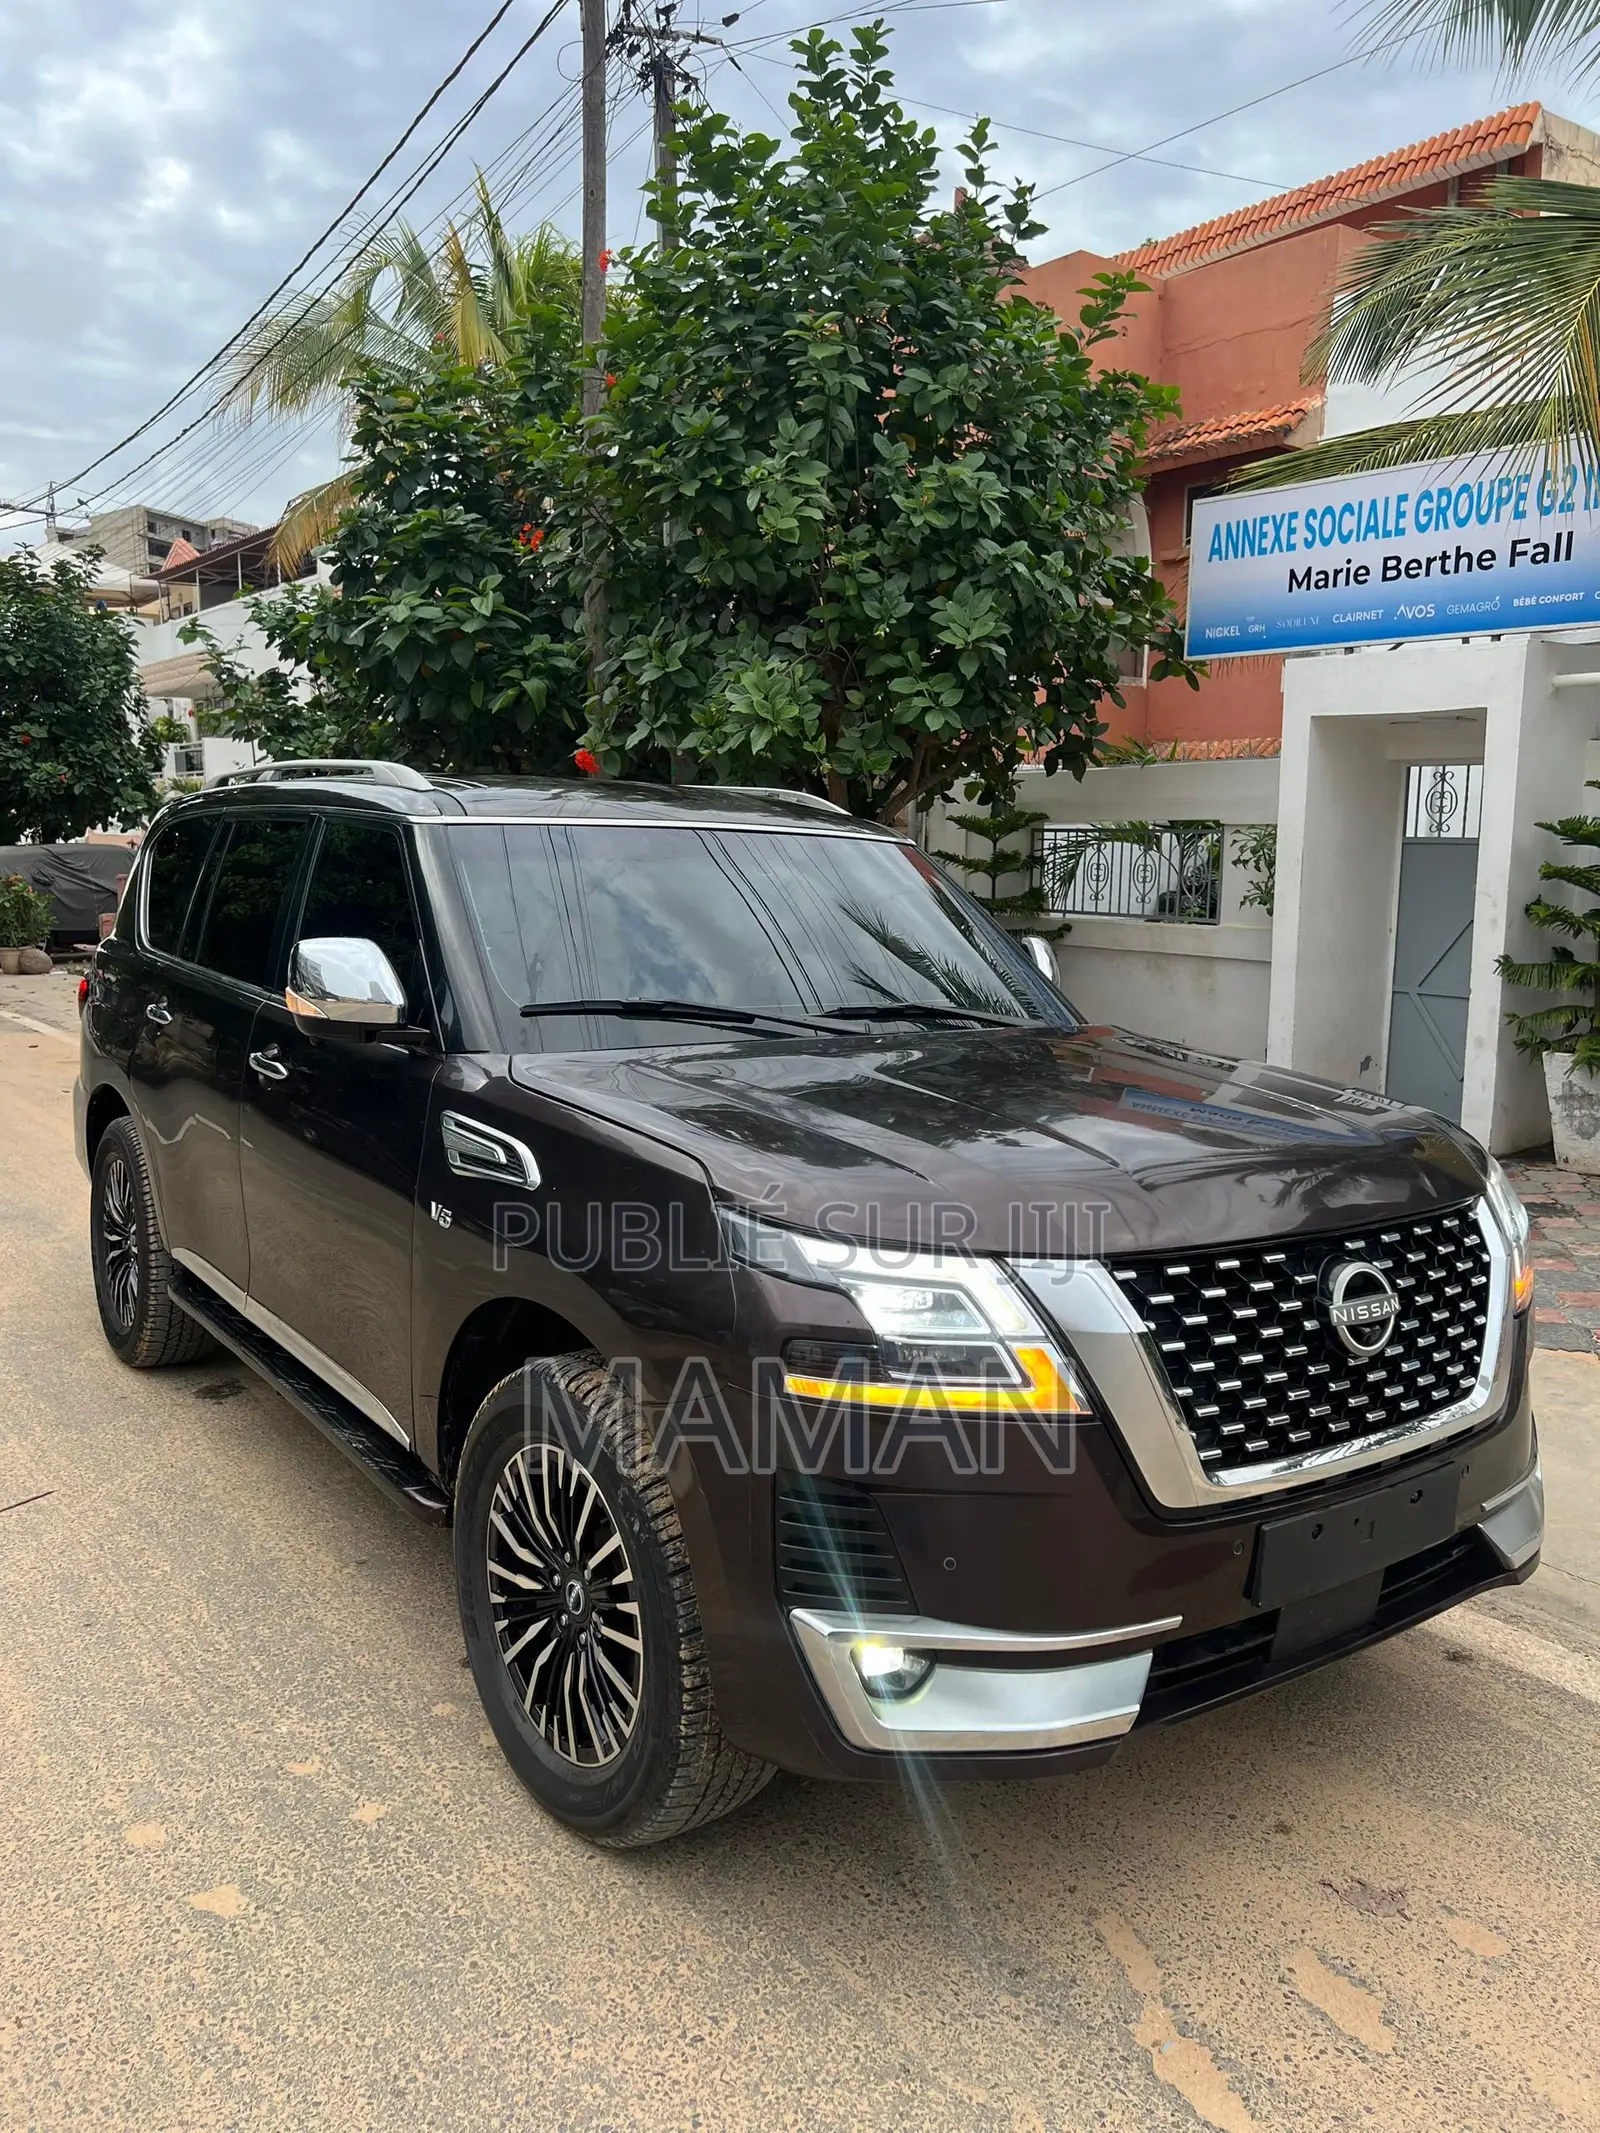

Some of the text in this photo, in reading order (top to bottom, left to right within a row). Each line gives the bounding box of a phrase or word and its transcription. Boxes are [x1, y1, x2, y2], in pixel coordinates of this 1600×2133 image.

[1208, 511, 1298, 563] ANNEXE
[1303, 493, 1408, 550] SOCIALE
[1414, 474, 1530, 533] GROUPE
[1536, 463, 1577, 517] G2
[1288, 530, 1574, 593] Marie Berthe Fall
[1538, 592, 1585, 604] CONFORT
[1332, 609, 1384, 624] CLAIRNET
[1205, 625, 1240, 638] NICKEL
[1333, 1296, 1400, 1323] NISSAN
